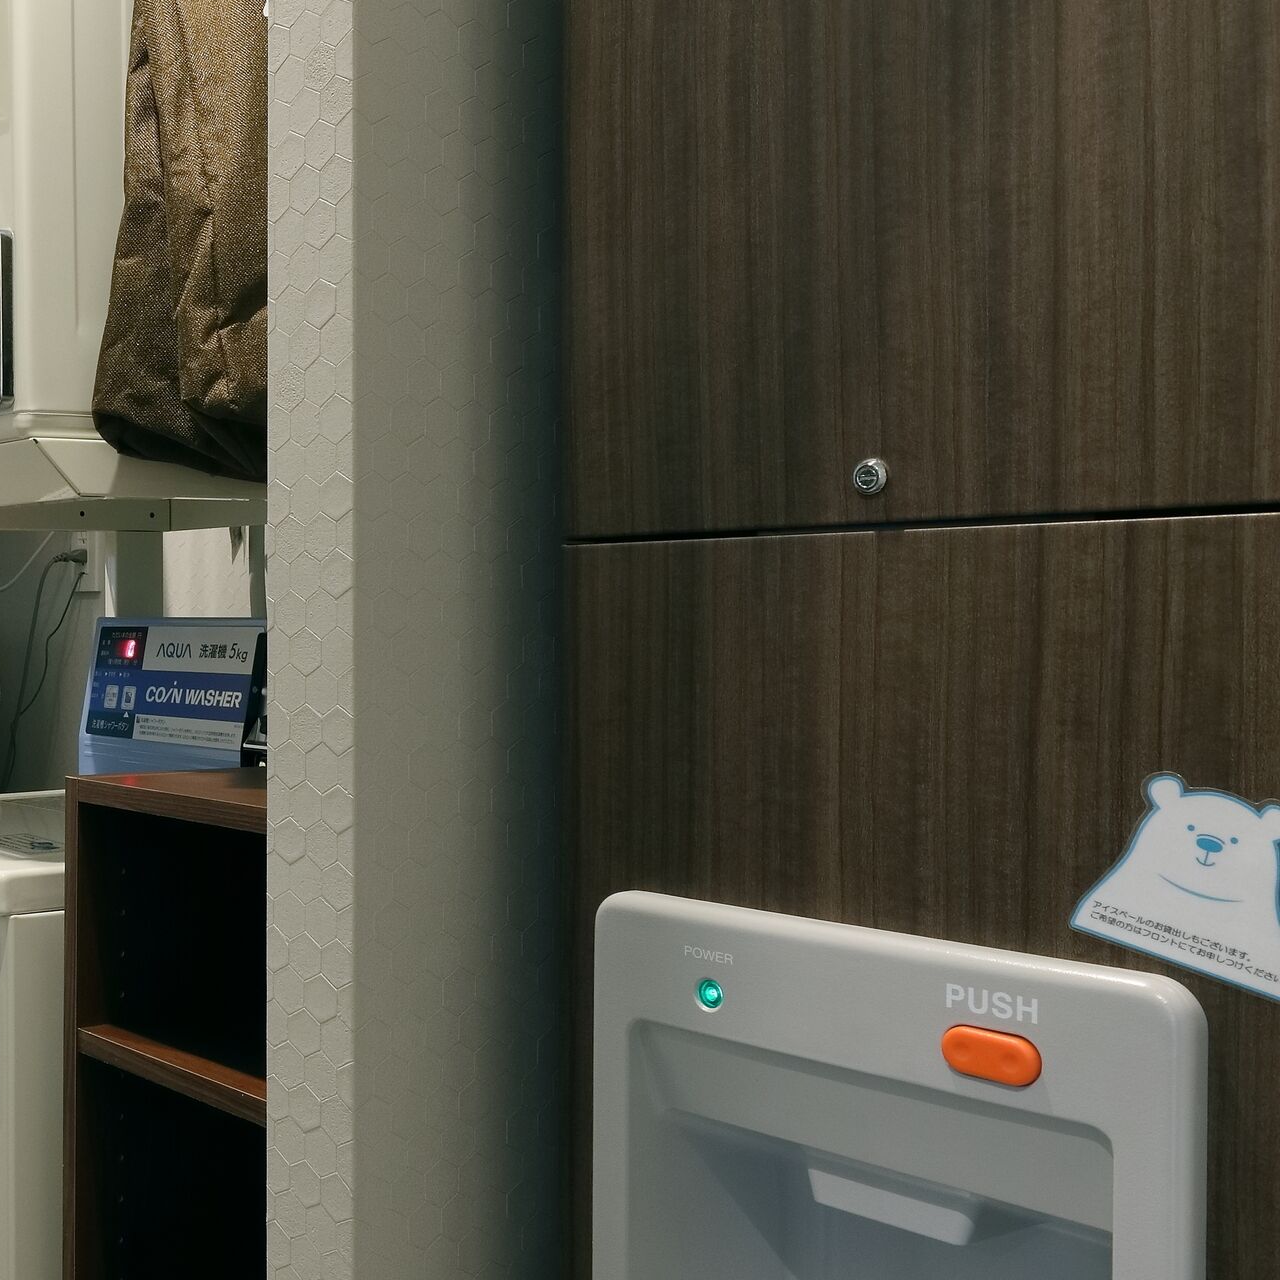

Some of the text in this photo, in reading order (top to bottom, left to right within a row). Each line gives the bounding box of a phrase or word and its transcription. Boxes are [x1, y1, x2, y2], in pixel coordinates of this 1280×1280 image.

[156, 642, 248, 663] AQUA 洗濯機 5kg
[145, 681, 242, 709] COIN WASHER
[1092, 900, 1251, 963] アイスペールのお貸出しもございます。
[684, 945, 734, 965] POWER
[945, 983, 1039, 1024] PUSH
